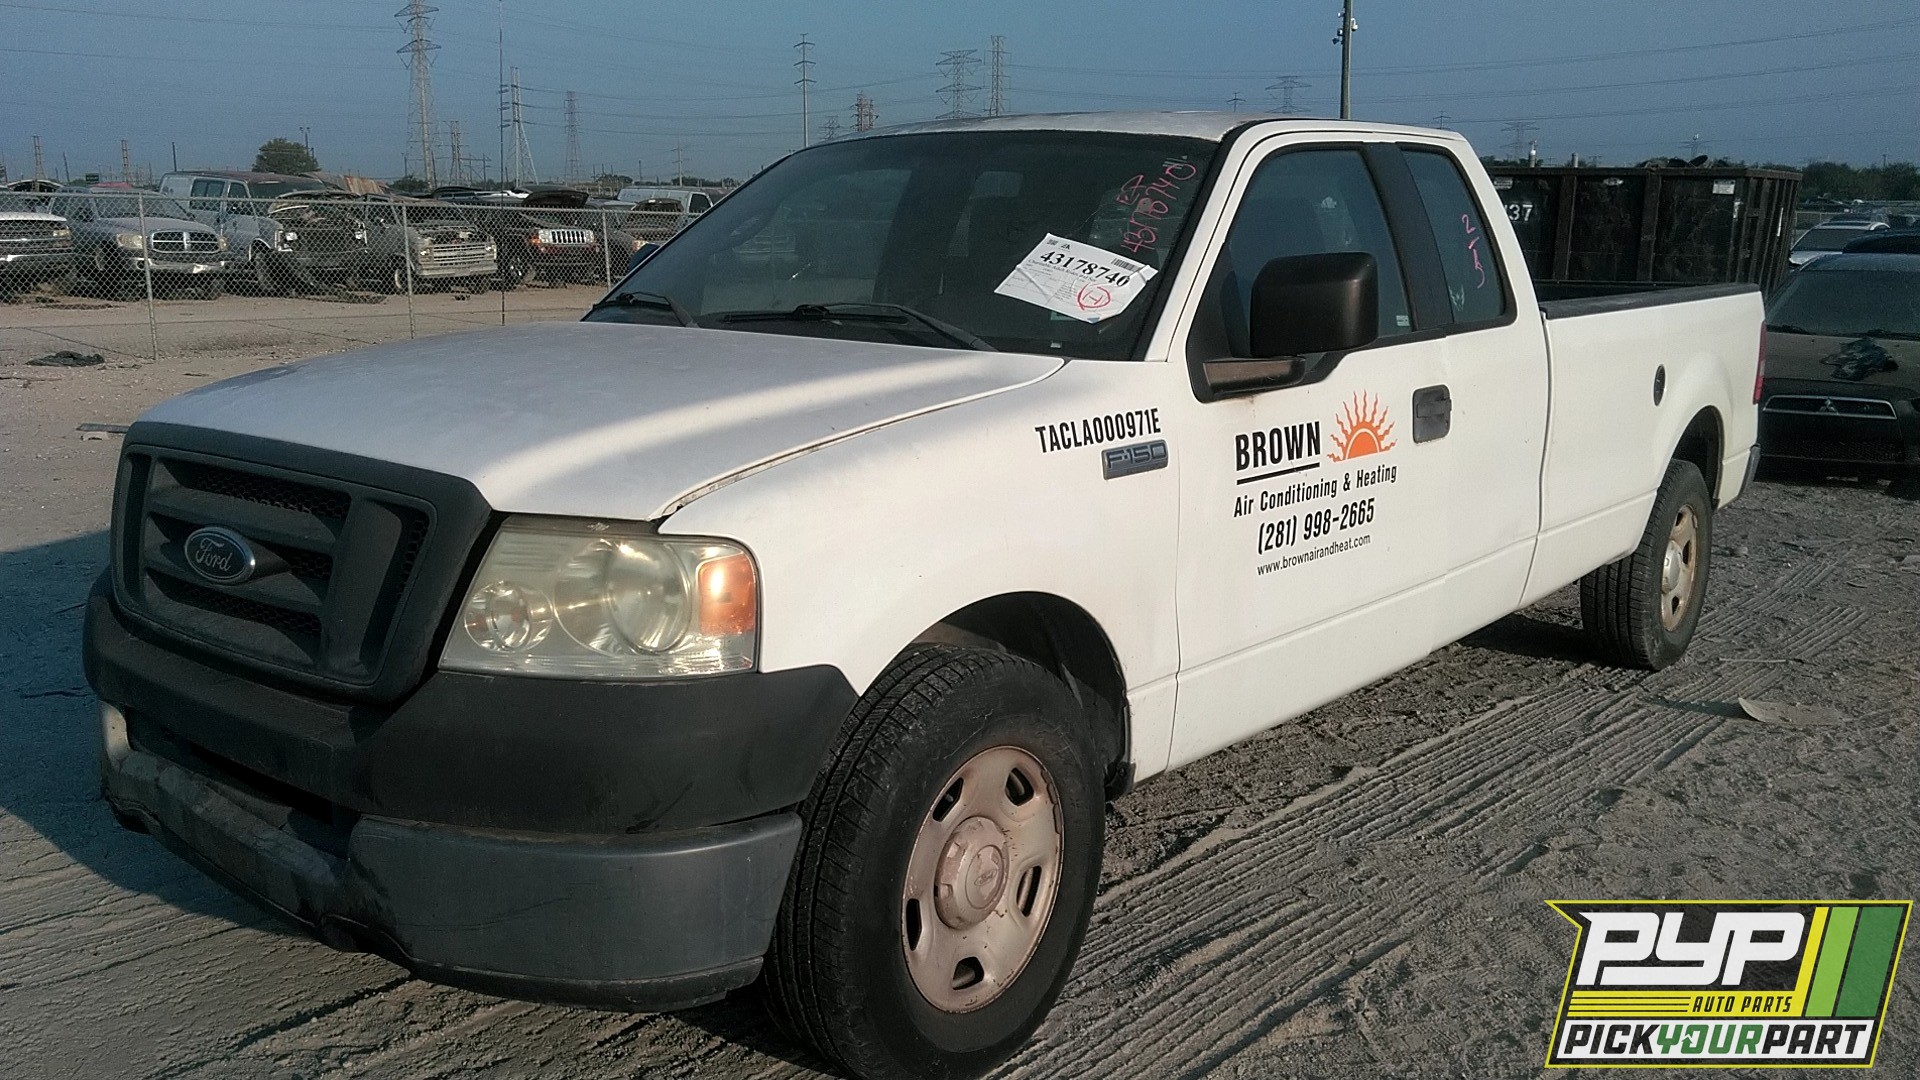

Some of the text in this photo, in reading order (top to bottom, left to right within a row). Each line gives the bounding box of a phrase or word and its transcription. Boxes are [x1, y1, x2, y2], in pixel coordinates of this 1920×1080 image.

[1504, 204, 1533, 221] 37
[1040, 251, 1130, 287] 43178740
[1034, 407, 1161, 453] TACLA000971E
[1235, 421, 1321, 471] BROWN
[1105, 442, 1167, 469] F-150
[1233, 464, 1398, 517] Air Conditioning & Heating
[1257, 498, 1375, 555] (281) 998-2665
[195, 537, 233, 572] Ford
[1257, 533, 1371, 576] www.brownairandheat.com
